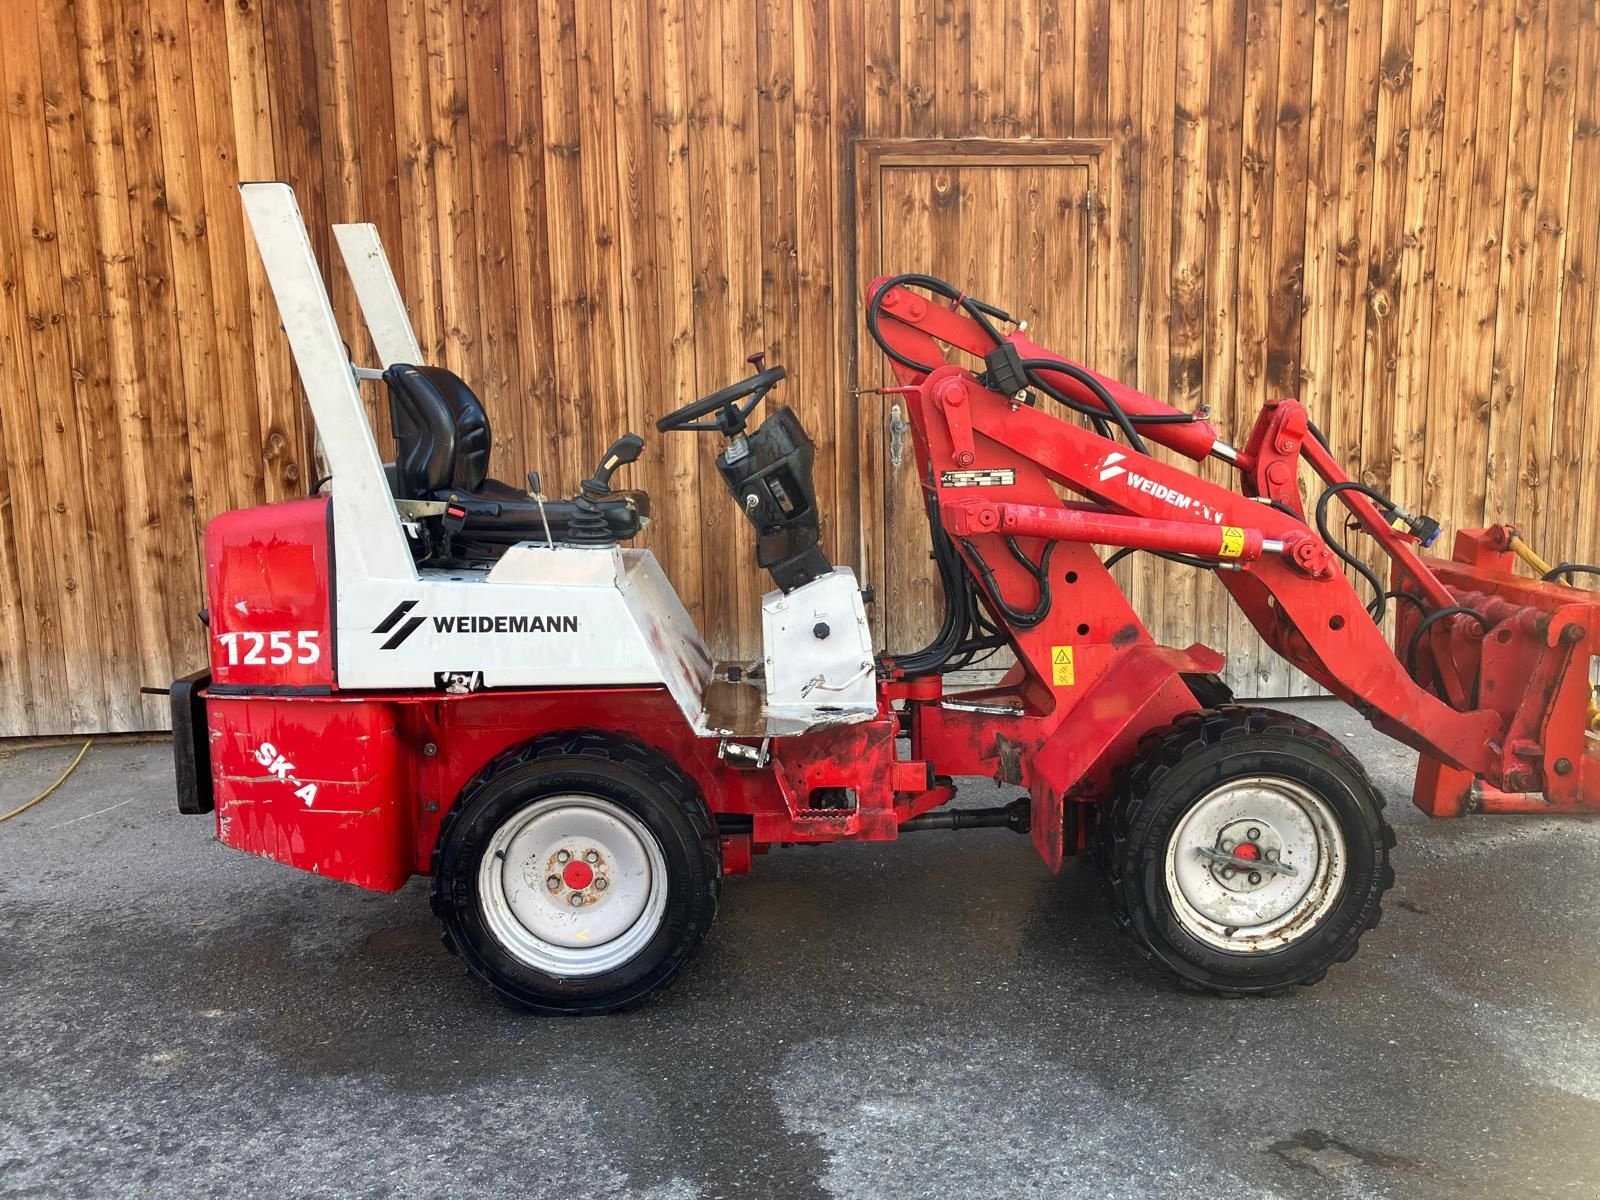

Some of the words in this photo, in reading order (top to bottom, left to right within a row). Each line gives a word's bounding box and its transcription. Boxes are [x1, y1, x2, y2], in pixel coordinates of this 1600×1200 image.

[1126, 471, 1224, 524] WEIDEM
[433, 615, 578, 633] WEIDEMANN
[219, 630, 320, 666] 1255
